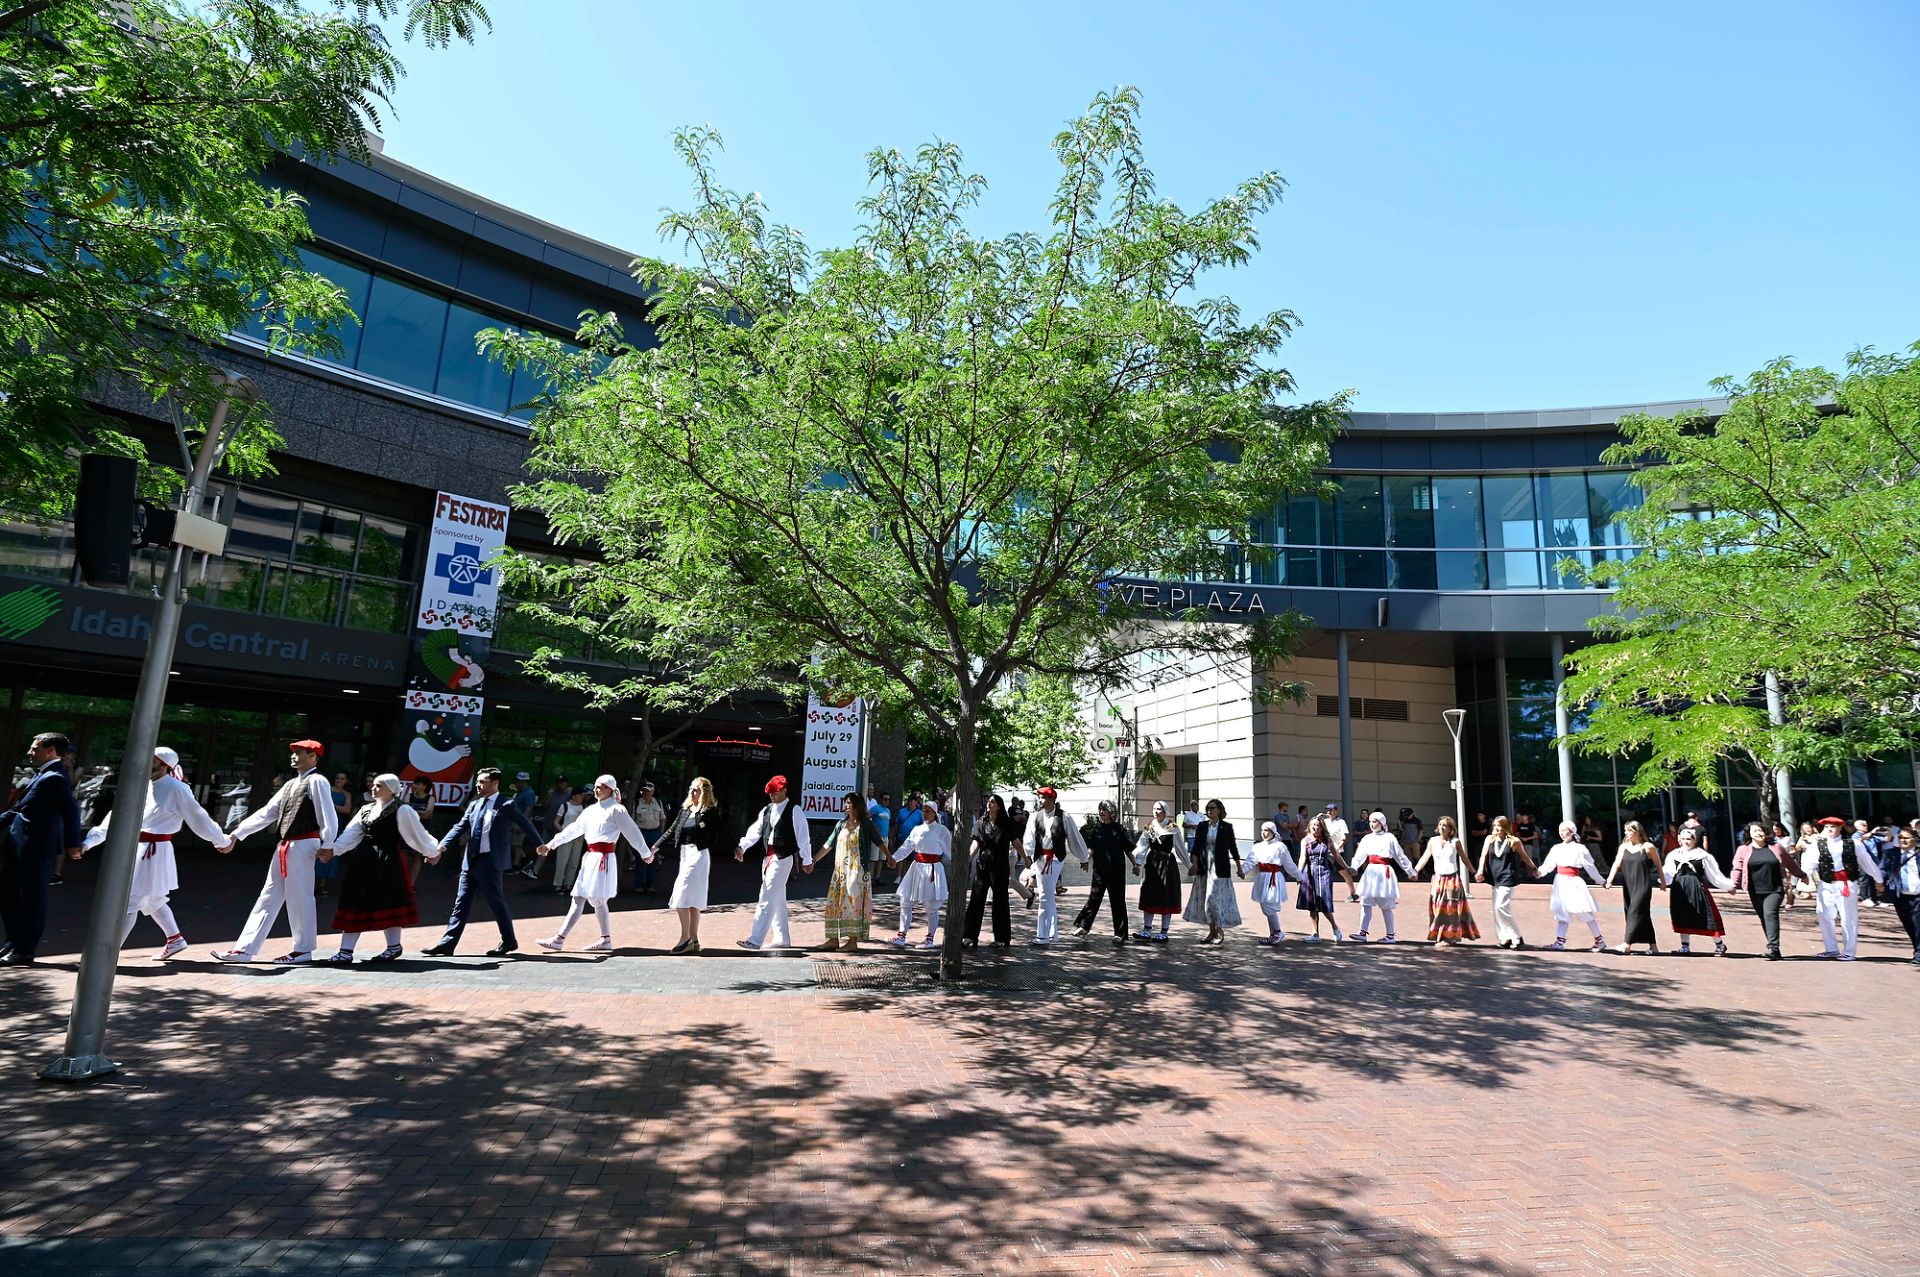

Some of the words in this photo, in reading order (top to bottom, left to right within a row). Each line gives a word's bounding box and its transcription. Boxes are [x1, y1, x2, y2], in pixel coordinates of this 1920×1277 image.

[436, 494, 507, 532] FESTARA
[434, 526, 473, 541] Sponsored
[474, 535, 485, 543] by
[1171, 588, 1265, 613] PLAZA
[69, 606, 150, 642] Idah
[185, 622, 309, 662] Central
[319, 650, 395, 672] ARENA
[811, 730, 836, 743] July
[839, 732, 852, 743] 29
[825, 744, 838, 755] to
[804, 757, 847, 769] August
[850, 759, 856, 769] 3
